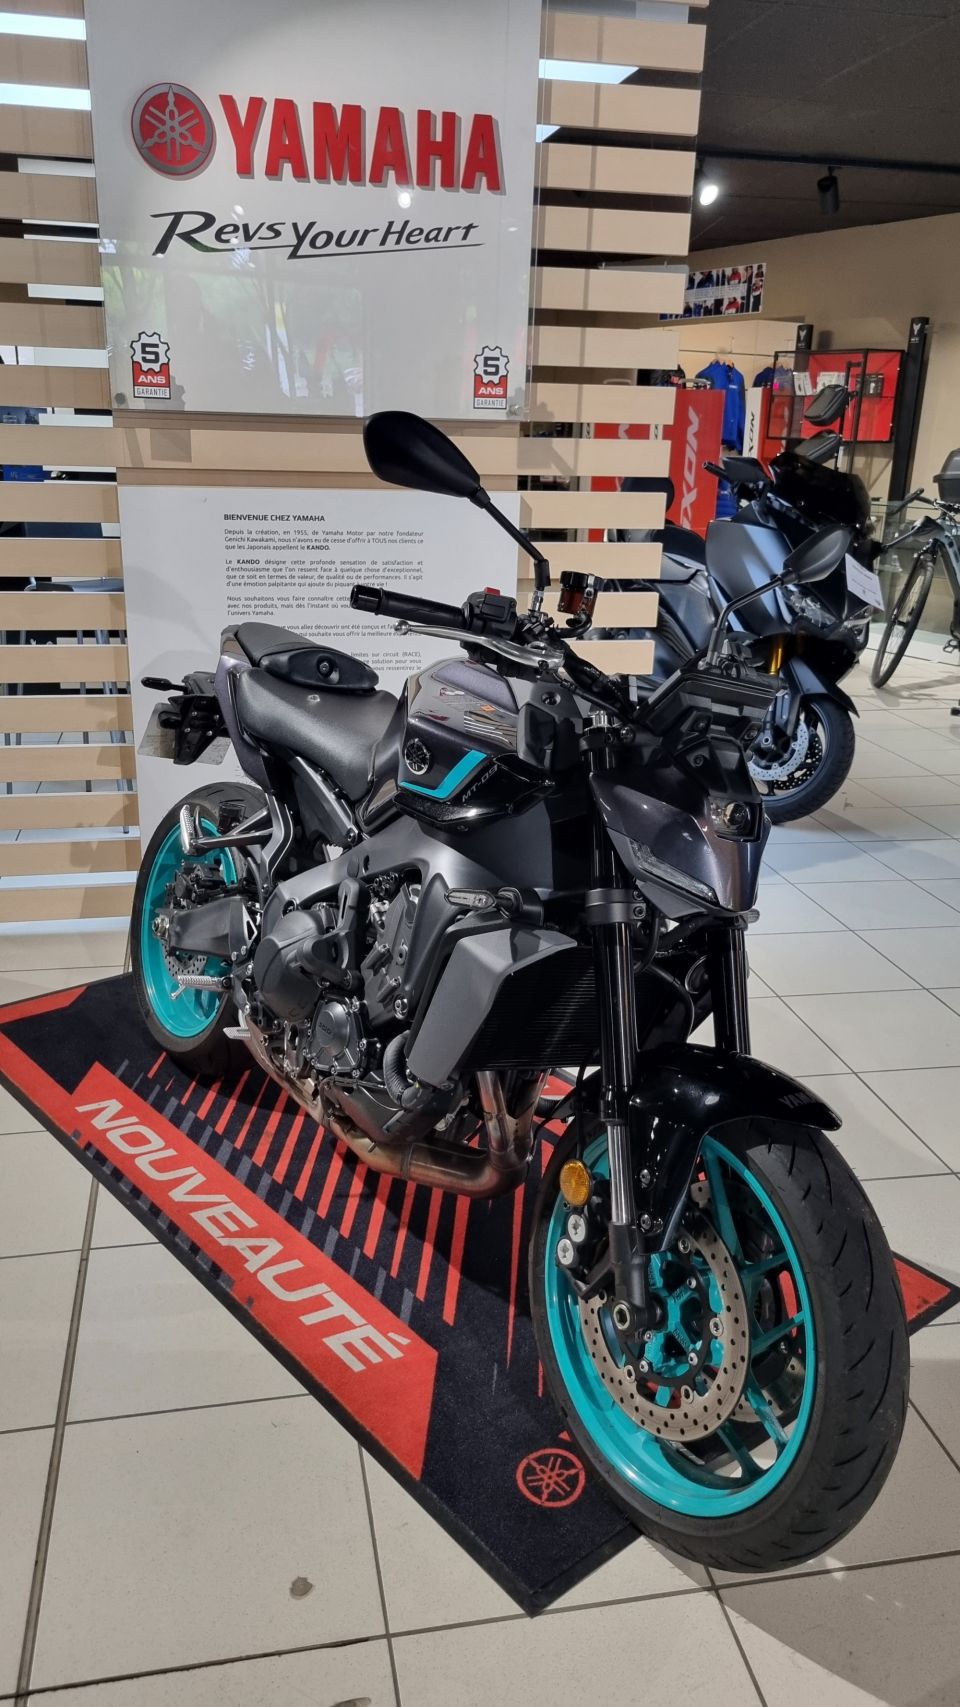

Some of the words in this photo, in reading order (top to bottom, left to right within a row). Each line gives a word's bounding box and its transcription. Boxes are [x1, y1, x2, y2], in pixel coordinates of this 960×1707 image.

[219, 94, 503, 193] YAMAHA
[150, 211, 287, 256] Revs
[287, 220, 379, 260] Your
[378, 219, 480, 247] Heart
[140, 342, 160, 364] 5
[483, 356, 500, 376] 5
[138, 375, 166, 384] ANS
[136, 387, 168, 397] GARANTIE
[478, 387, 504, 395] ANS
[462, 764, 498, 802] MT-09
[75, 1099, 411, 1373] NOUVEAUTÉ
